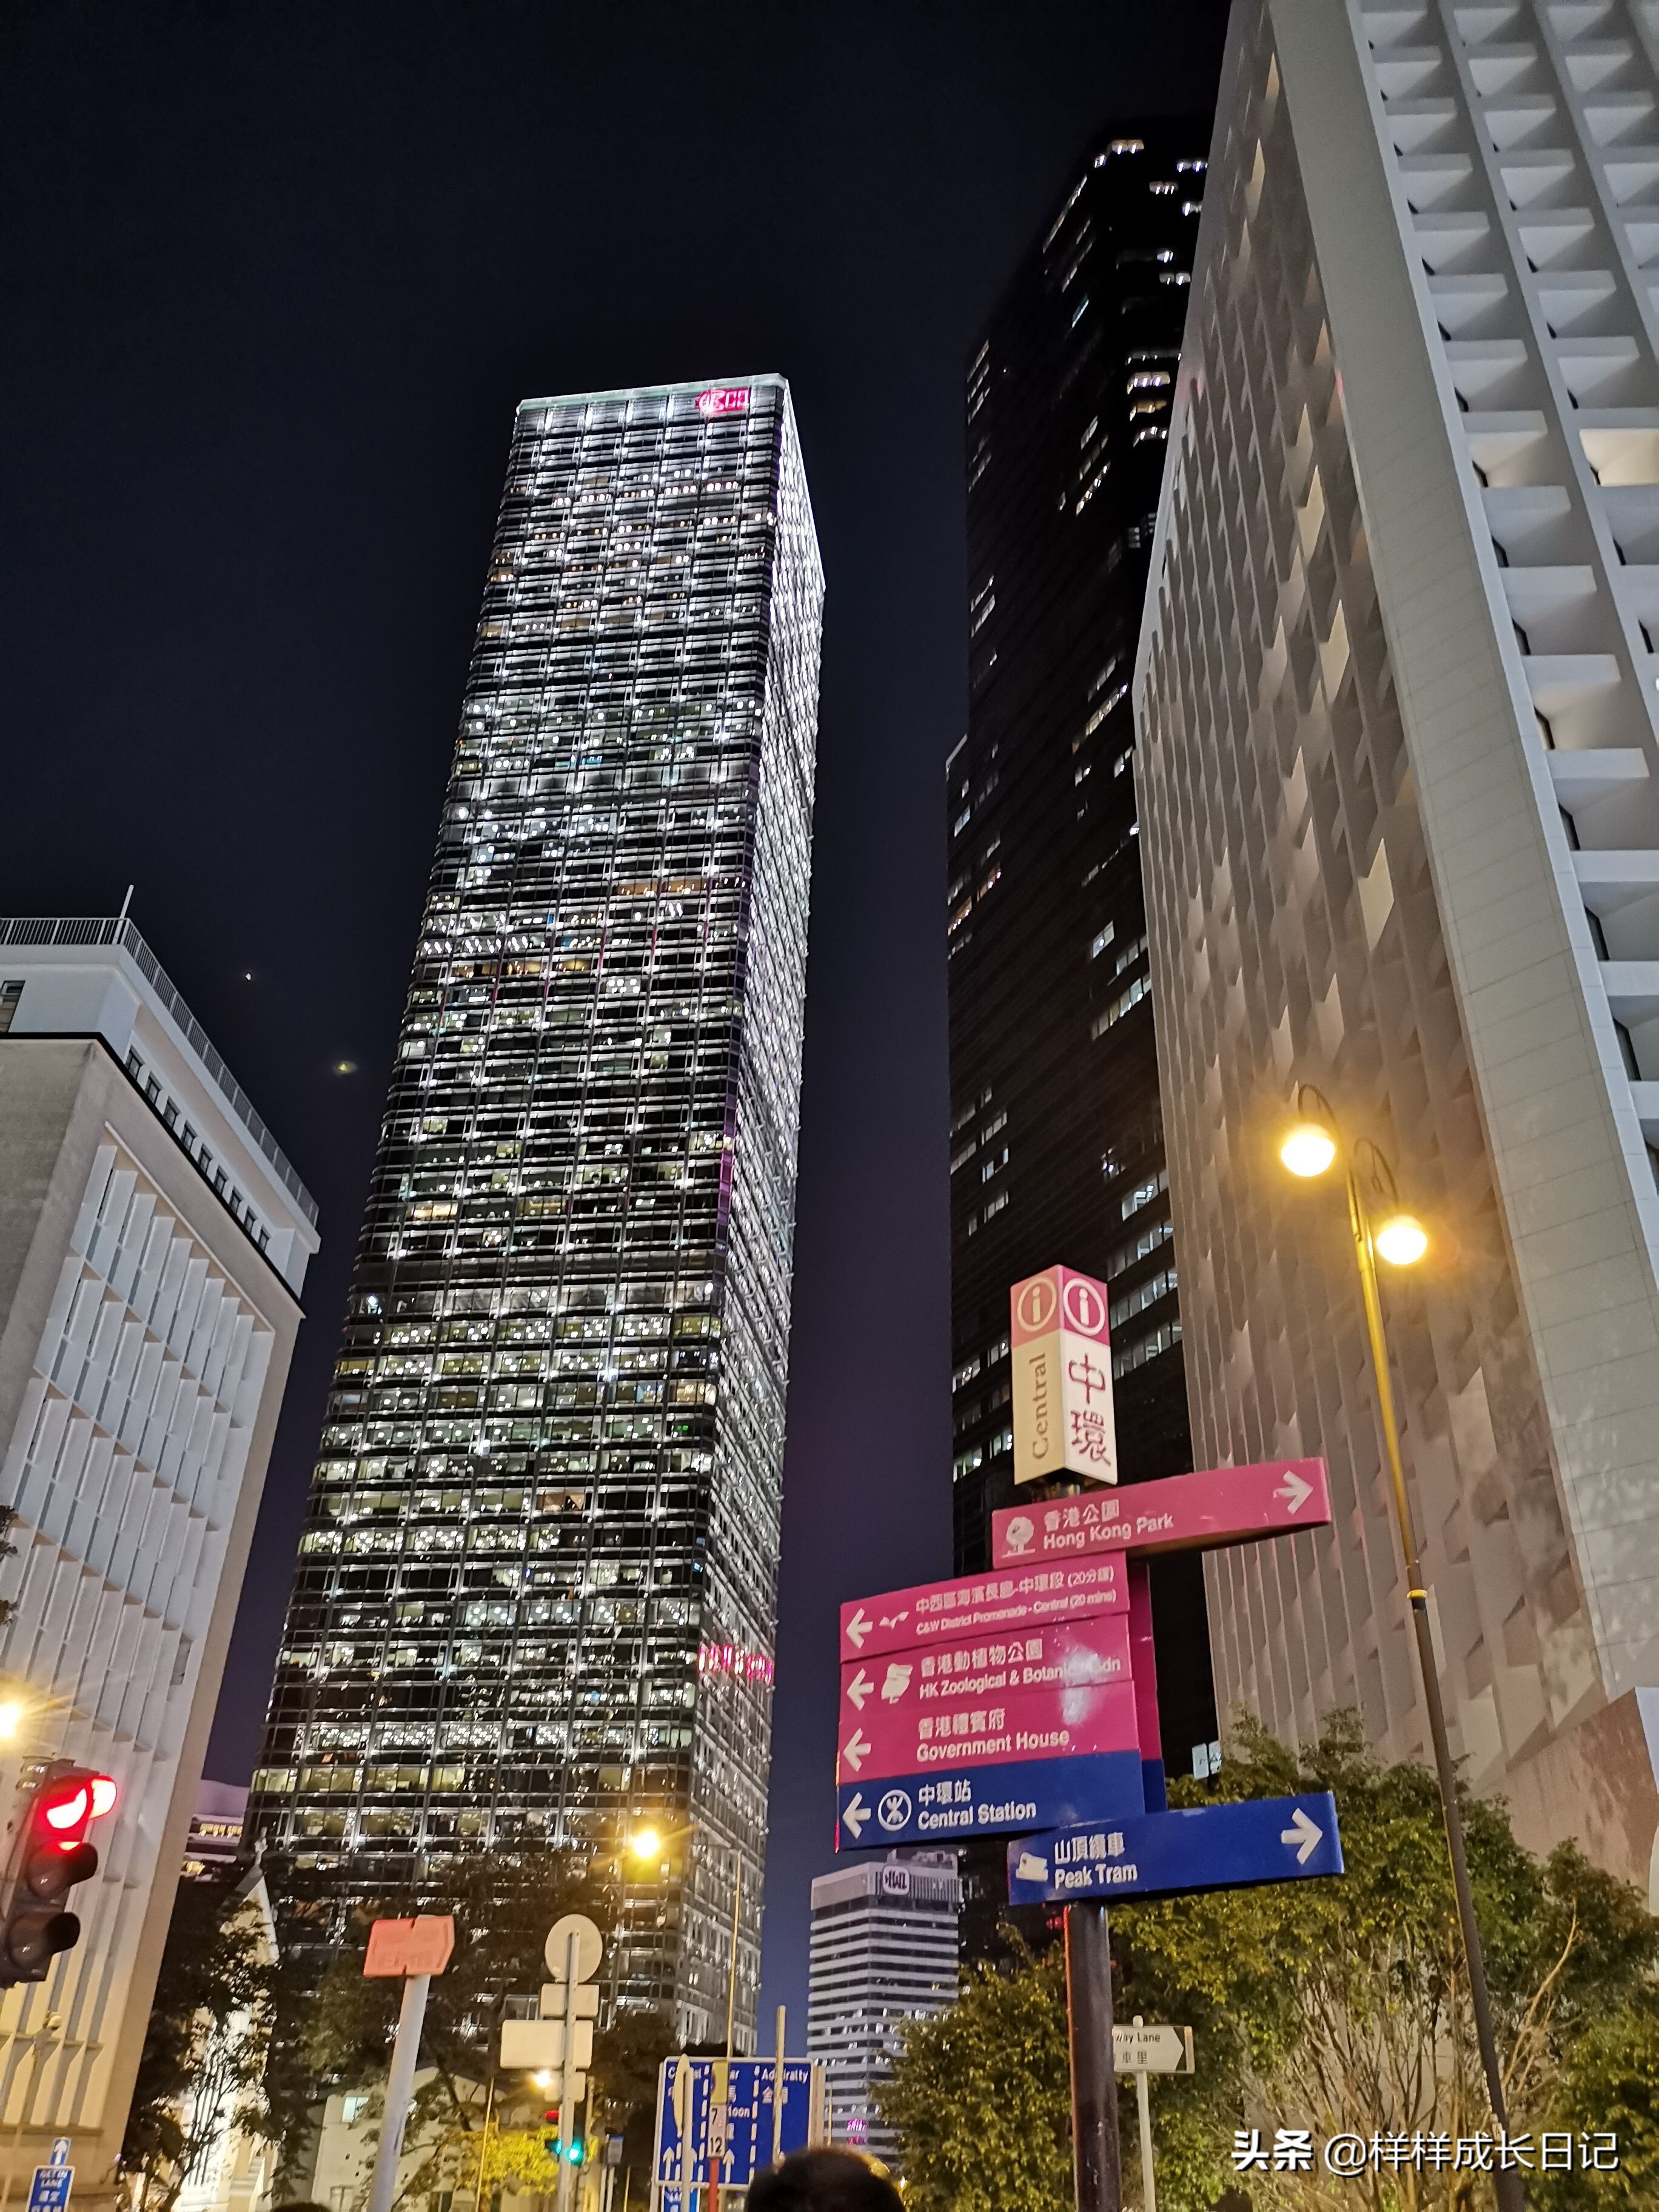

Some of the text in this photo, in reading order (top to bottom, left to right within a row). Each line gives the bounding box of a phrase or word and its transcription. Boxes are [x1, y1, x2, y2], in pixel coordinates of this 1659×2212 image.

[1029, 1353, 1048, 1460] Central
[1068, 1353, 1111, 1467] 中環
[1044, 1499, 1119, 1532] 香港公園
[1044, 1513, 1175, 1549] Hong Kong Park
[916, 1620, 940, 1636] C&W
[940, 1614, 973, 1631] District
[973, 1604, 1027, 1624] Promenade
[1033, 1597, 1068, 1615] Central
[1070, 1593, 1086, 1610] (20
[1087, 1588, 1117, 1605] mins)
[920, 1638, 1043, 1678] 香港動植物公園
[919, 1683, 939, 1700] HK
[940, 1671, 1007, 1697] Zoological
[1010, 1669, 1020, 1686] &
[918, 1708, 1005, 1740] 香港禮賓府
[917, 1730, 1070, 1762] Government House
[918, 1778, 971, 1807] 中環站
[918, 1801, 1036, 1831] Central Station
[1054, 1832, 1125, 1865] 山頂纜車
[1054, 1863, 1138, 1891] Peak Tram
[1137, 2031, 1161, 2043] Lane
[761, 2066, 809, 2084] Adiralty
[711, 2108, 718, 2125] 7
[709, 2136, 722, 2153] 12
